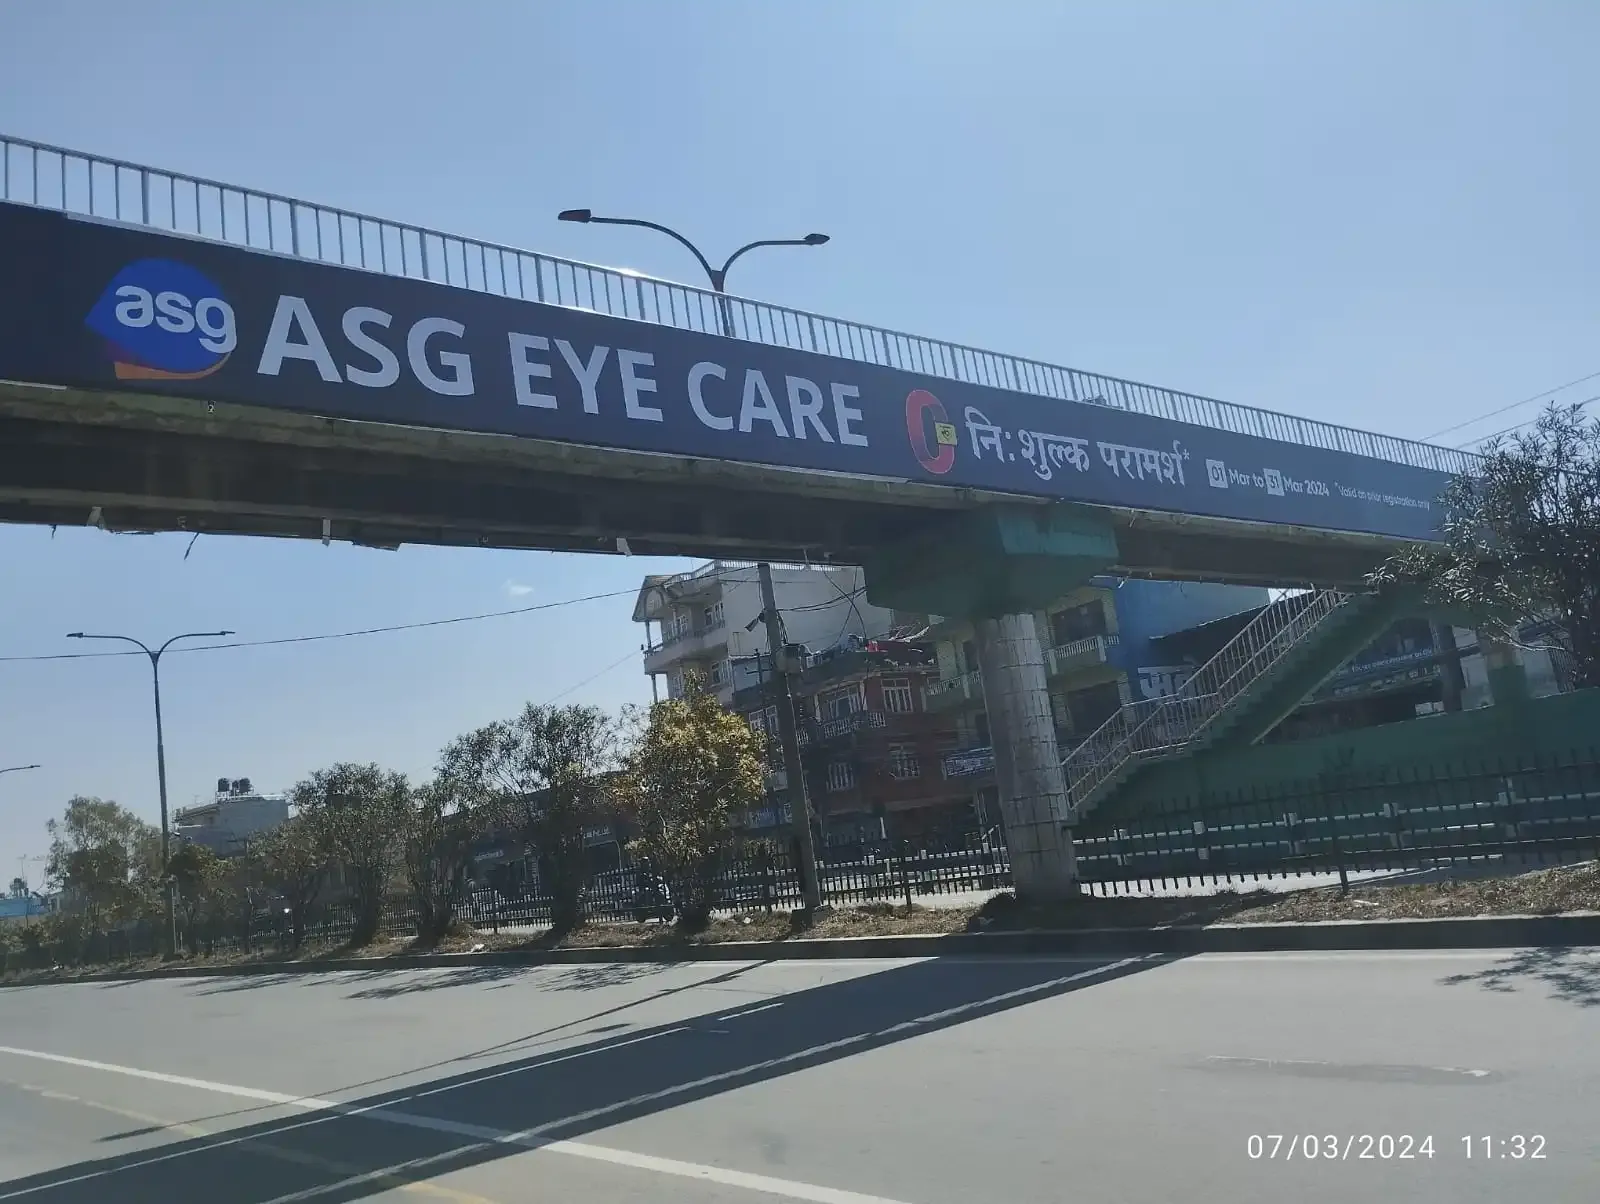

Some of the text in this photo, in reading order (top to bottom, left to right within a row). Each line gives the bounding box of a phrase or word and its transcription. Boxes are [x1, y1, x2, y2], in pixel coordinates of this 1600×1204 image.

[115, 285, 237, 353] asg
[257, 294, 869, 447] ASG EYE CARE
[1211, 464, 1330, 496] 01 Mar to 31 Mar 2024
